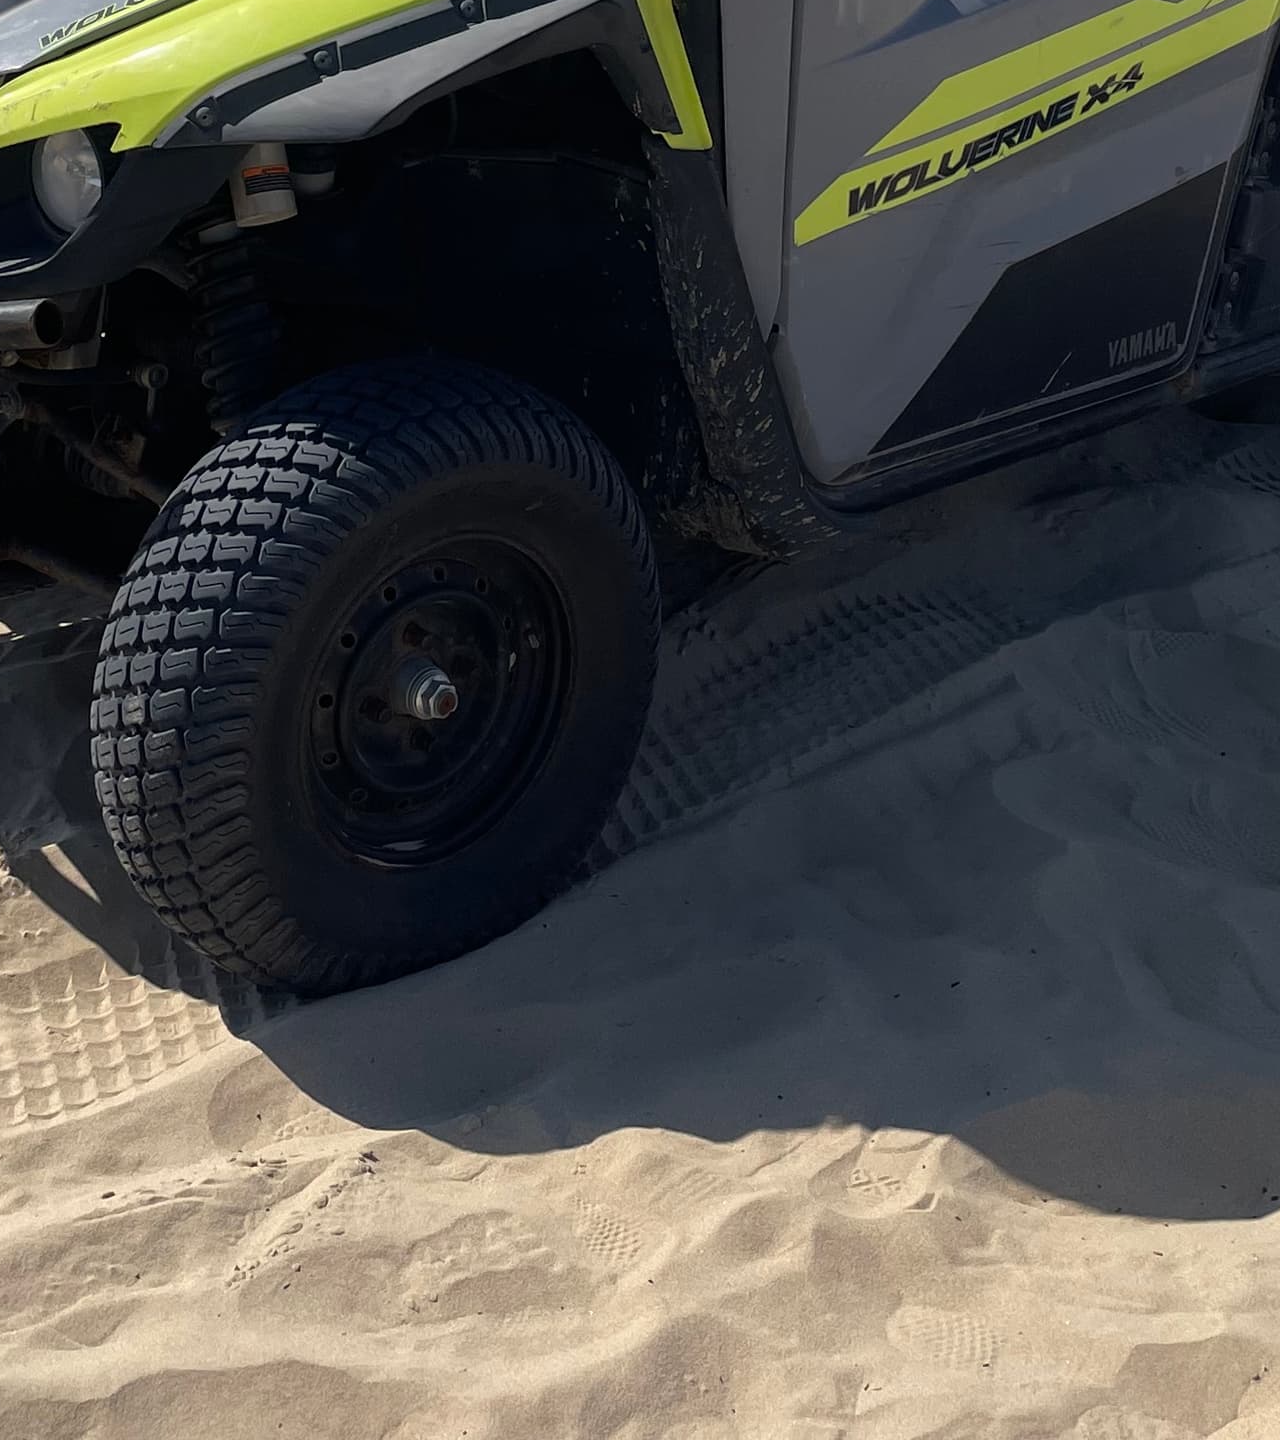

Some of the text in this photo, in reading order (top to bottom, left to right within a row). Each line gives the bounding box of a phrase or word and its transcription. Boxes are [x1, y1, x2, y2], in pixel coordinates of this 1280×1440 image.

[848, 60, 1145, 218] WOLVERINE X4
[1108, 320, 1177, 369] YAMAHA
